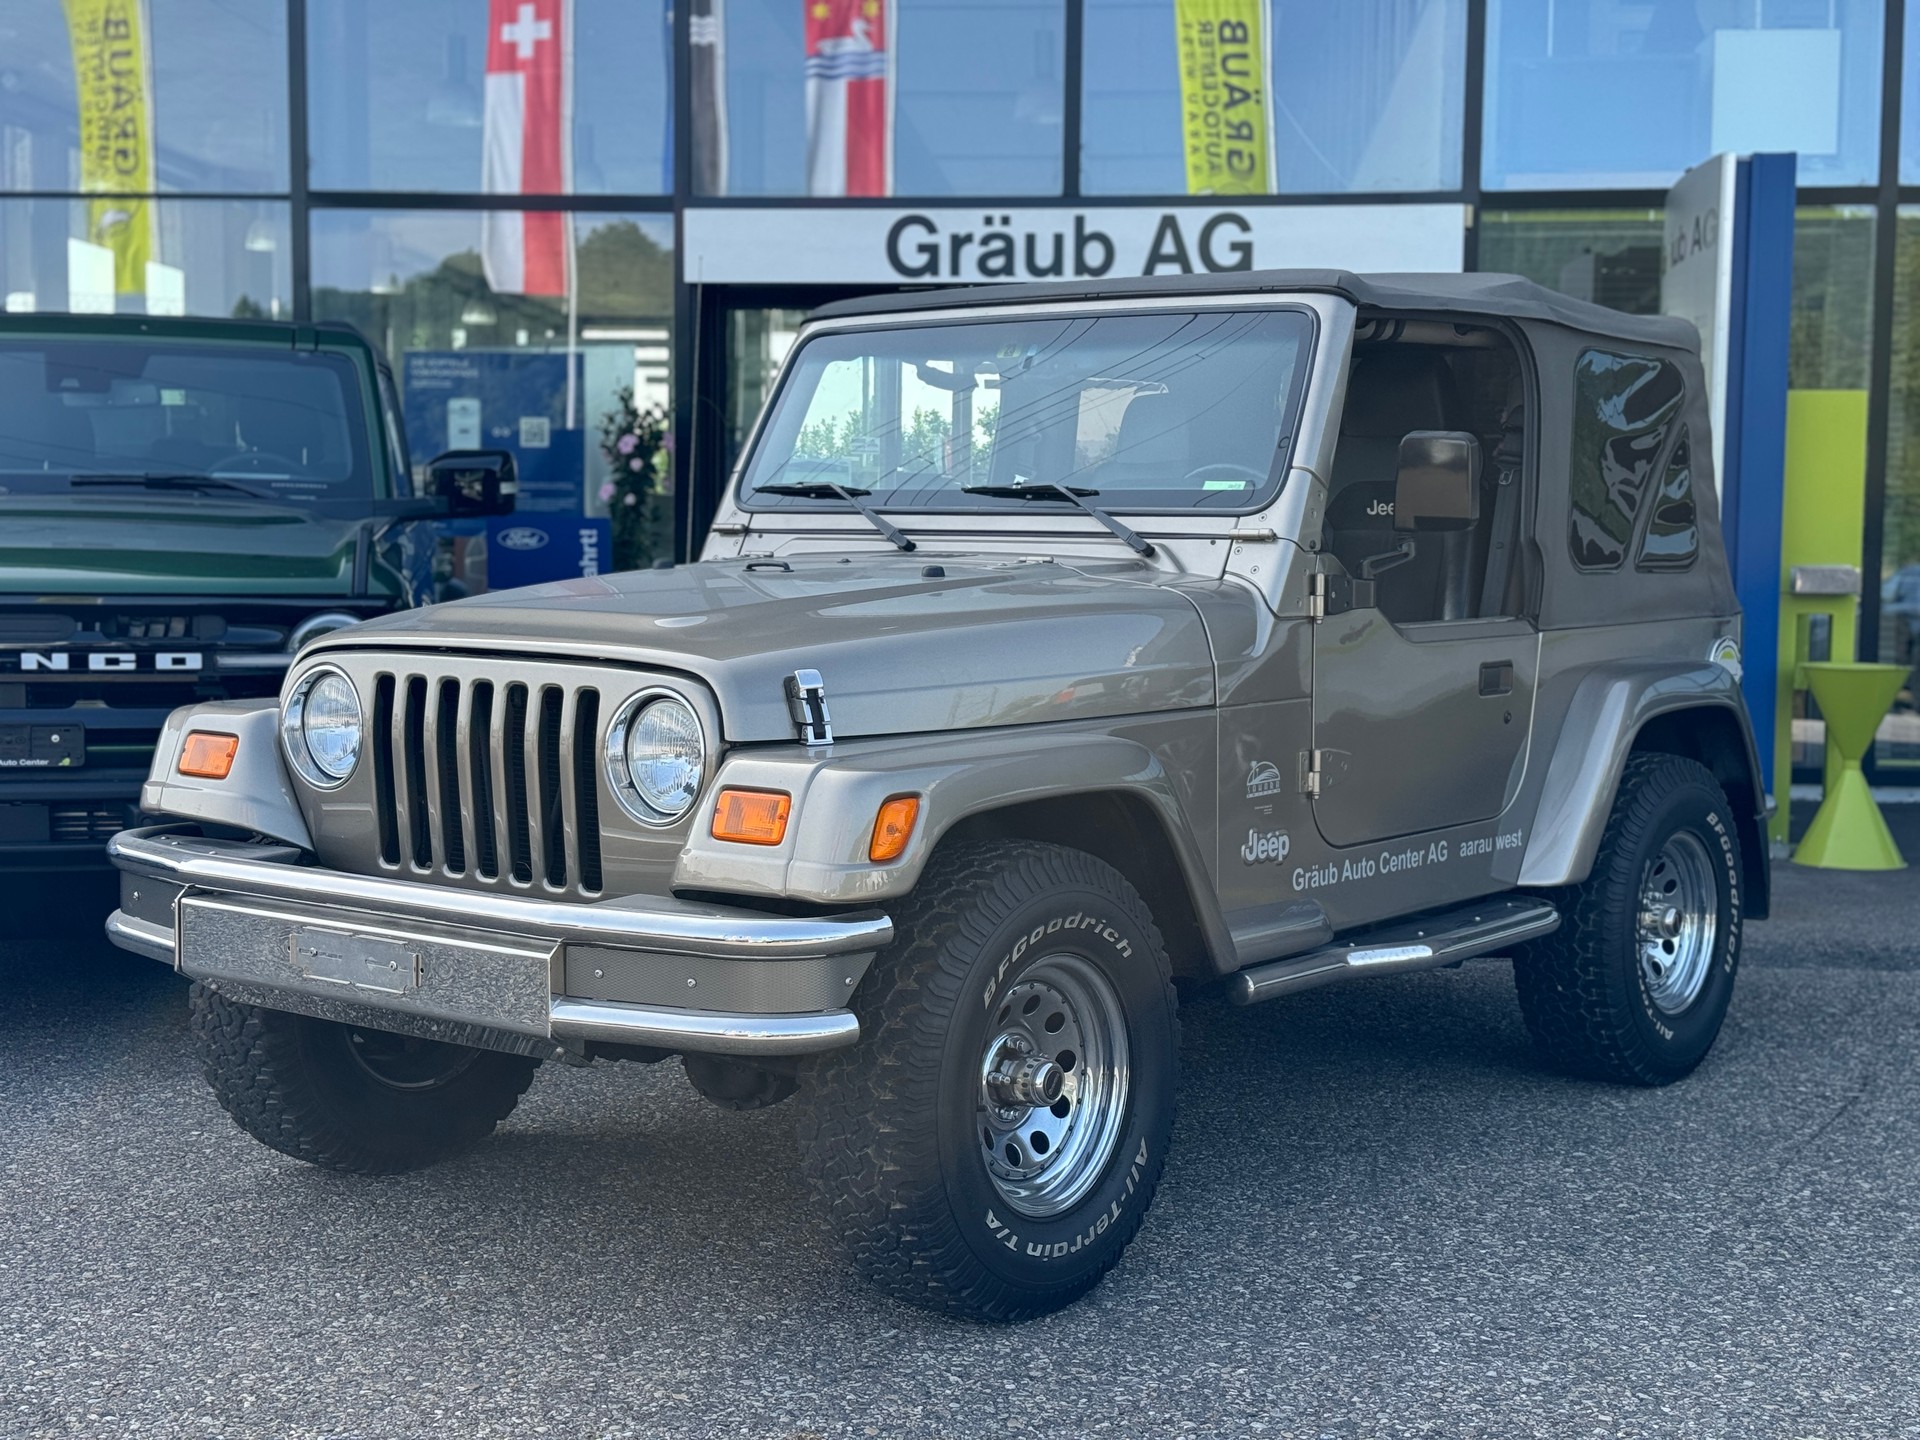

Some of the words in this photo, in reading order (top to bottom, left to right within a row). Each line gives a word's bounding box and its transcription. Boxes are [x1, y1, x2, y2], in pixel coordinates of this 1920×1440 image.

[886, 214, 1115, 278] Gräub
[1142, 212, 1254, 275] AG
[1690, 208, 1719, 255] AG
[504, 528, 541, 547] Ford
[20, 652, 203, 670] NCO
[19, 758, 50, 767] Center
[1244, 830, 1290, 862] Jeep
[1292, 862, 1338, 891] Gräub
[1341, 857, 1376, 882] Auto
[1380, 848, 1425, 874] Center
[1427, 840, 1448, 865] AG
[1460, 836, 1492, 857] aarau
[1496, 828, 1522, 850] west
[1706, 811, 1740, 974] BFGoodrich
[983, 911, 1133, 1010] BFGoodrich
[1026, 1136, 1148, 1262] All-Terrain
